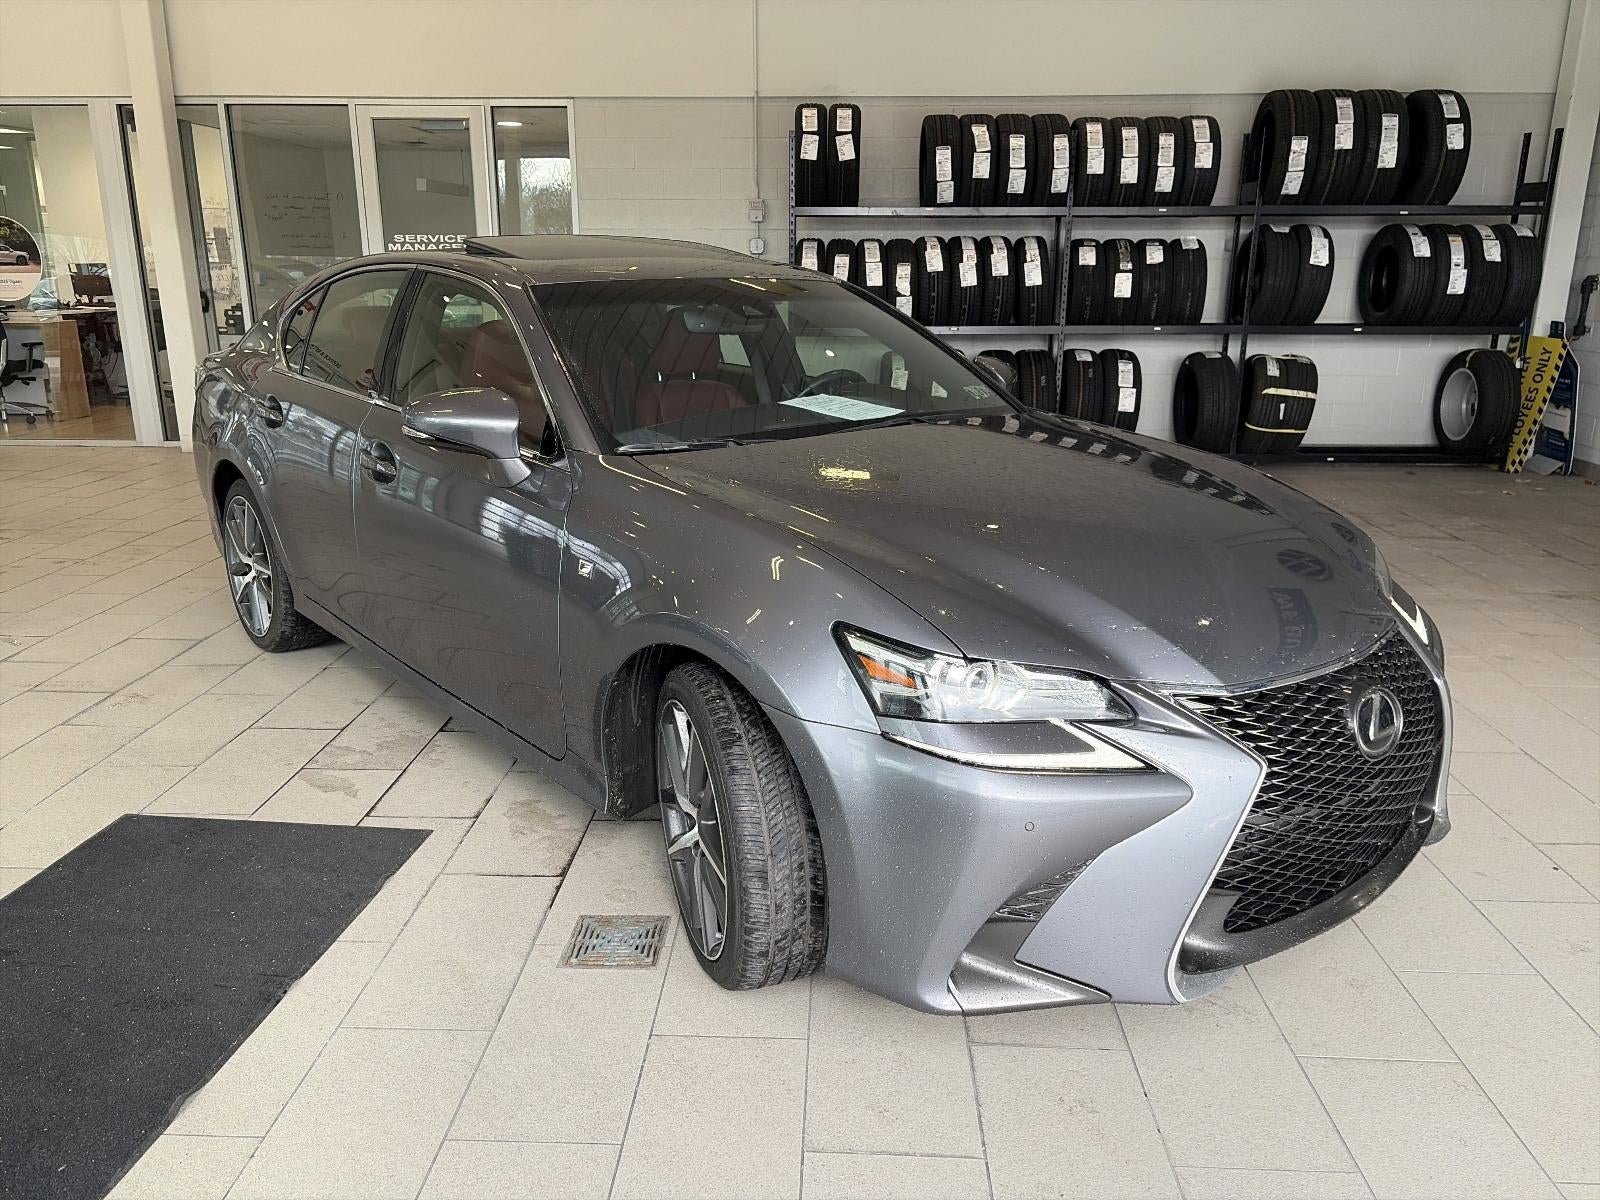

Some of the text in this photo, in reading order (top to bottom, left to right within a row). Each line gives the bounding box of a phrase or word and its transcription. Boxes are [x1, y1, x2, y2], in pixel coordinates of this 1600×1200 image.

[393, 234, 467, 243] SERVICE
[387, 243, 466, 251] MANAGE
[1532, 346, 1553, 384] ONLY
